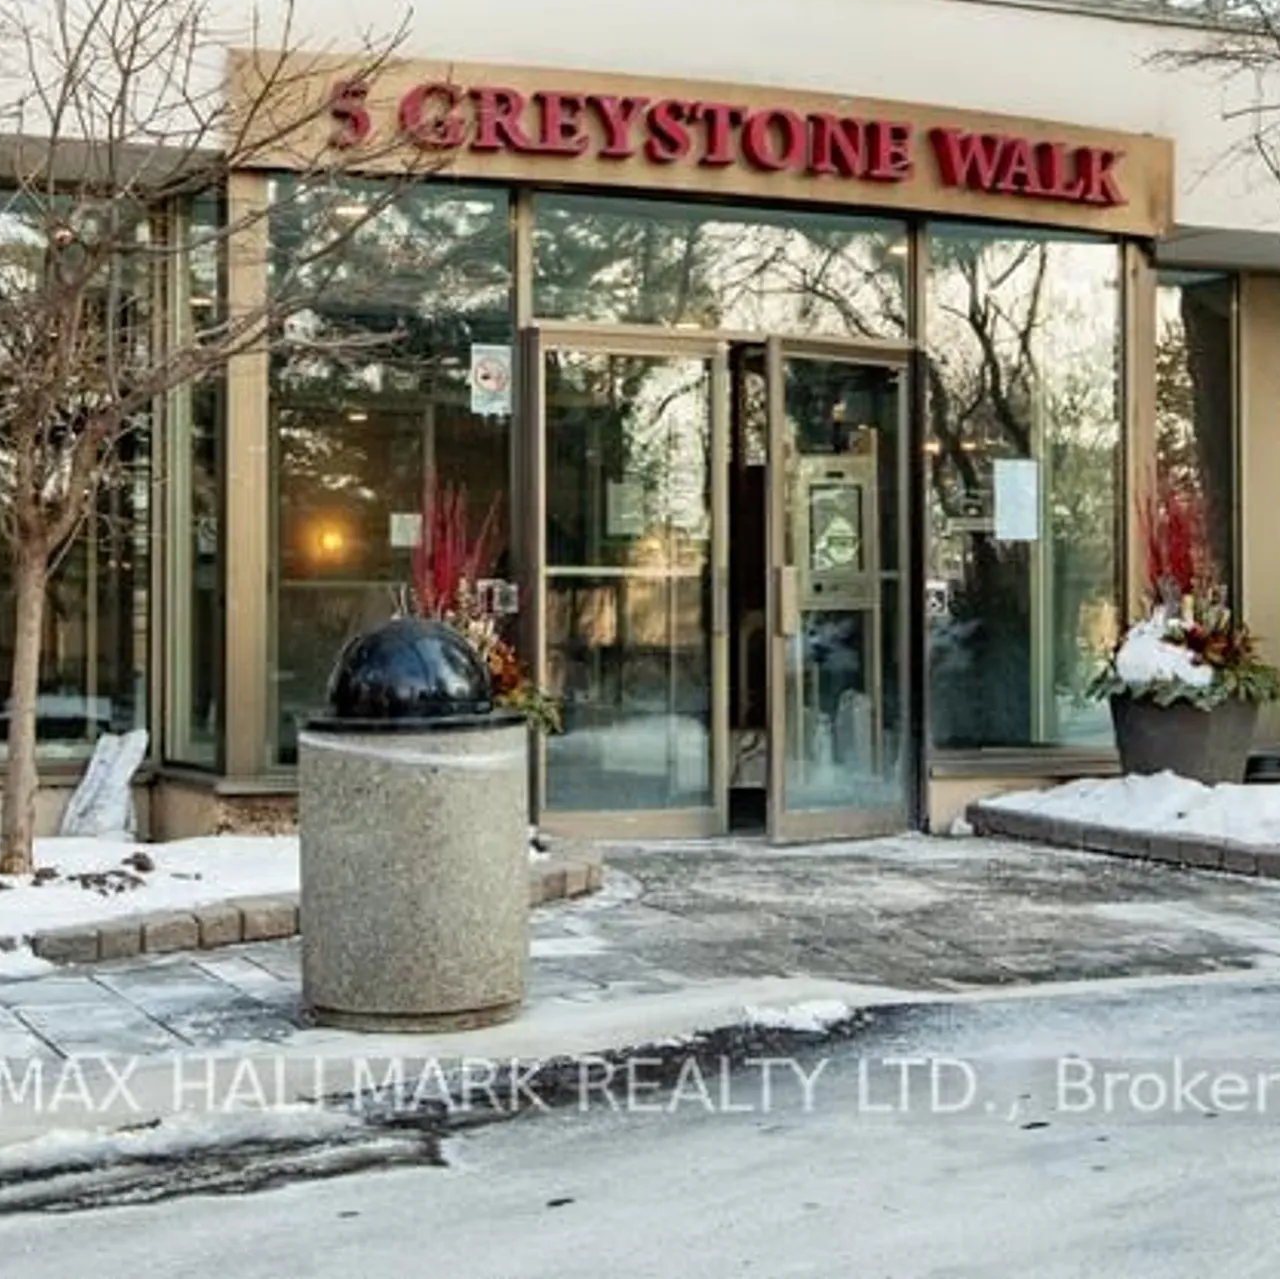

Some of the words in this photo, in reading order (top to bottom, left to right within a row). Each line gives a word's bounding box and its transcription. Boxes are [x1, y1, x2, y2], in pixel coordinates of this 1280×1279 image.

[328, 80, 370, 148] 5
[399, 82, 913, 181] GREYSTONE
[930, 127, 1127, 206] WALK
